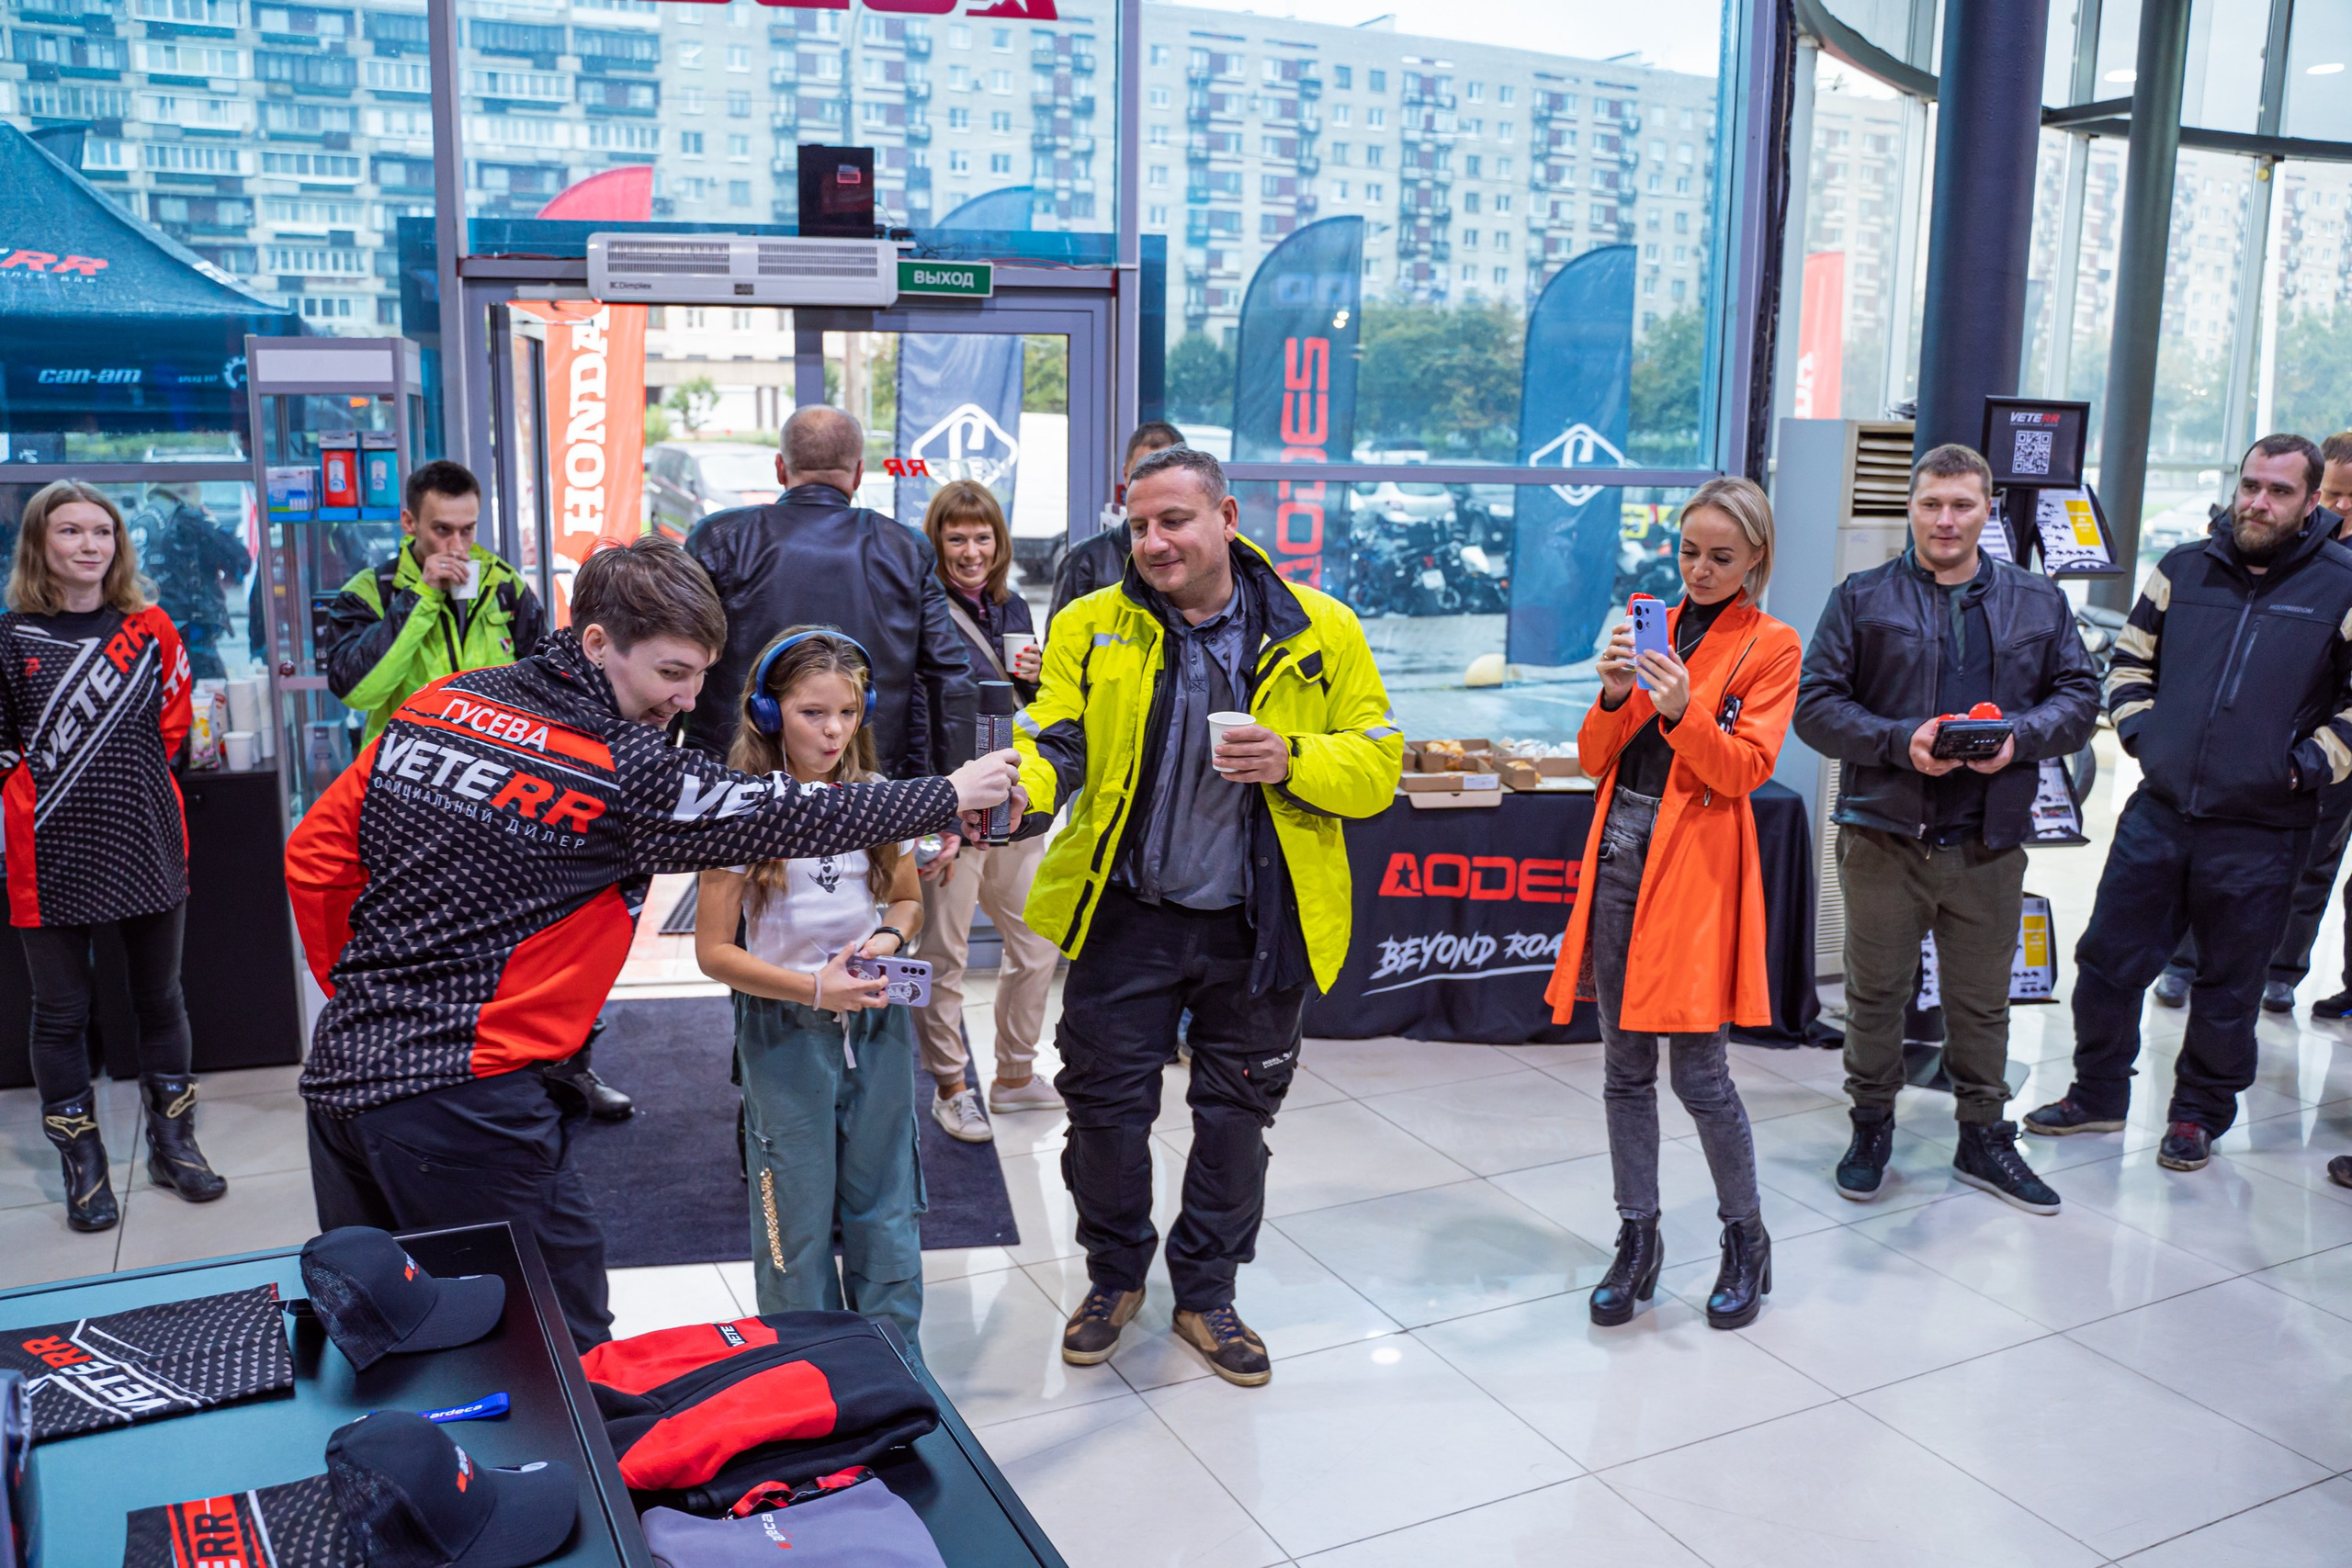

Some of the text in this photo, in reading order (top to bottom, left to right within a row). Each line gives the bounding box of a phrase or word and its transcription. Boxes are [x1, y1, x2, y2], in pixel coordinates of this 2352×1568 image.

[0, 248, 108, 276] RR
[913, 270, 975, 288] ВЫХОД
[39, 369, 141, 384] can-am
[563, 305, 610, 537] HONDA
[2009, 412, 2061, 423] VETERR
[41, 614, 154, 772] VETERR
[439, 699, 548, 751] ГУСЕВА
[378, 733, 606, 833] VETERR
[505, 818, 585, 849] ДИЛЕР
[1369, 930, 1498, 980] BEYOND
[22, 1335, 171, 1413] VETERR
[429, 1404, 483, 1419] ardeca
